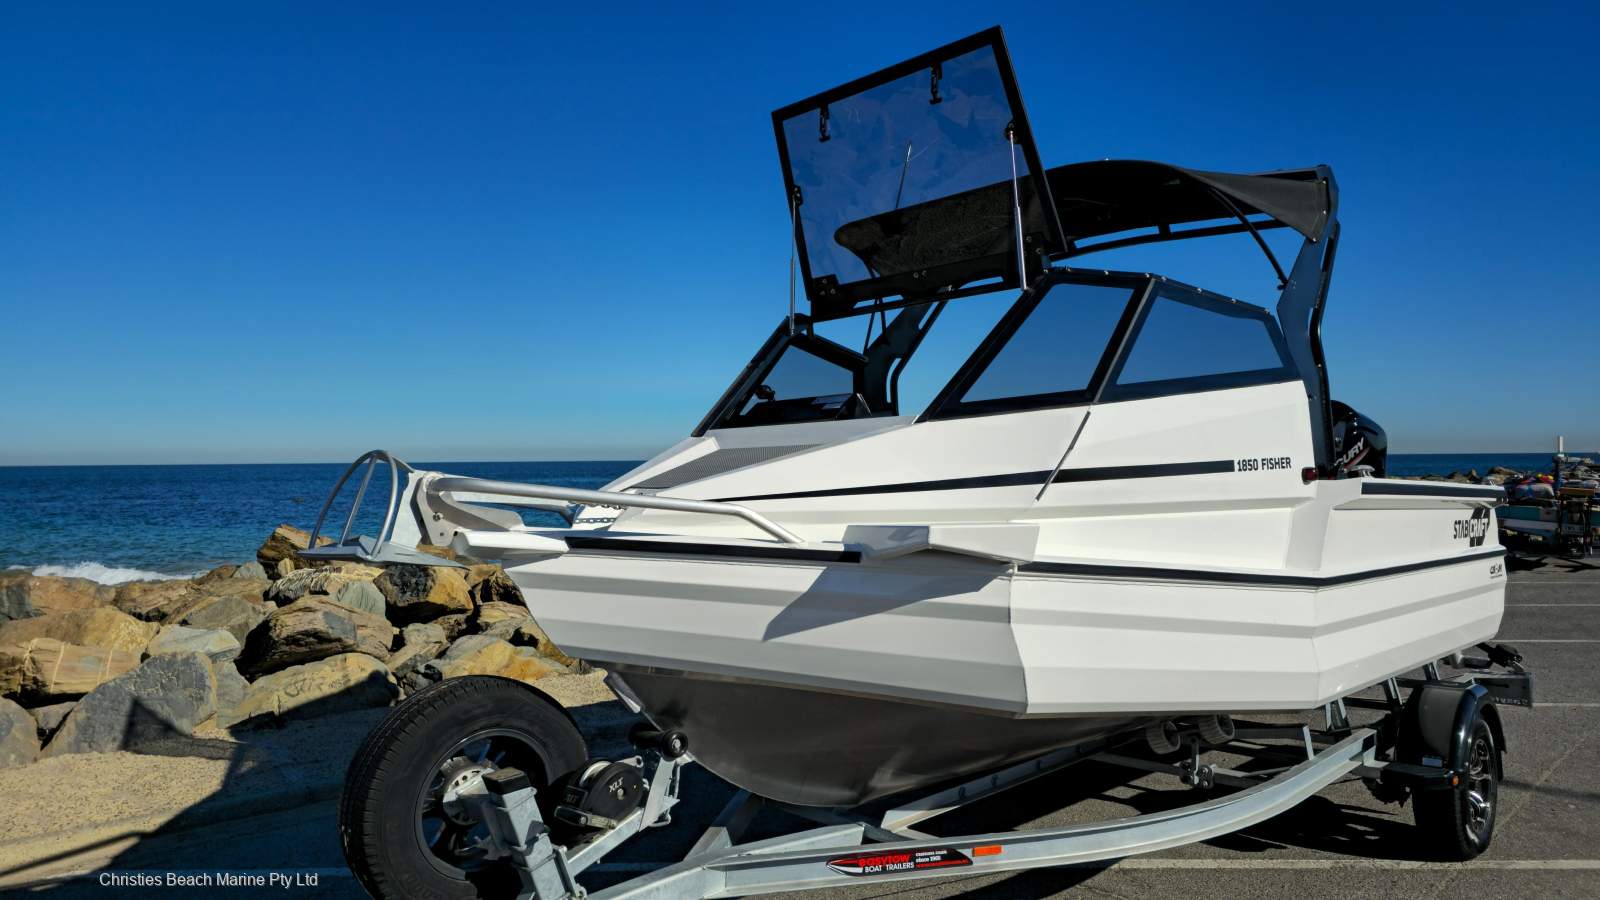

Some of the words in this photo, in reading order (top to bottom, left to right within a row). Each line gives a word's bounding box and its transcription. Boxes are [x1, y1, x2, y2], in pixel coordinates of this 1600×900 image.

[1237, 458, 1259, 472] 1850
[1261, 456, 1292, 470] FISHER
[864, 864, 882, 873] BOAT
[885, 861, 915, 871] TRAILERS
